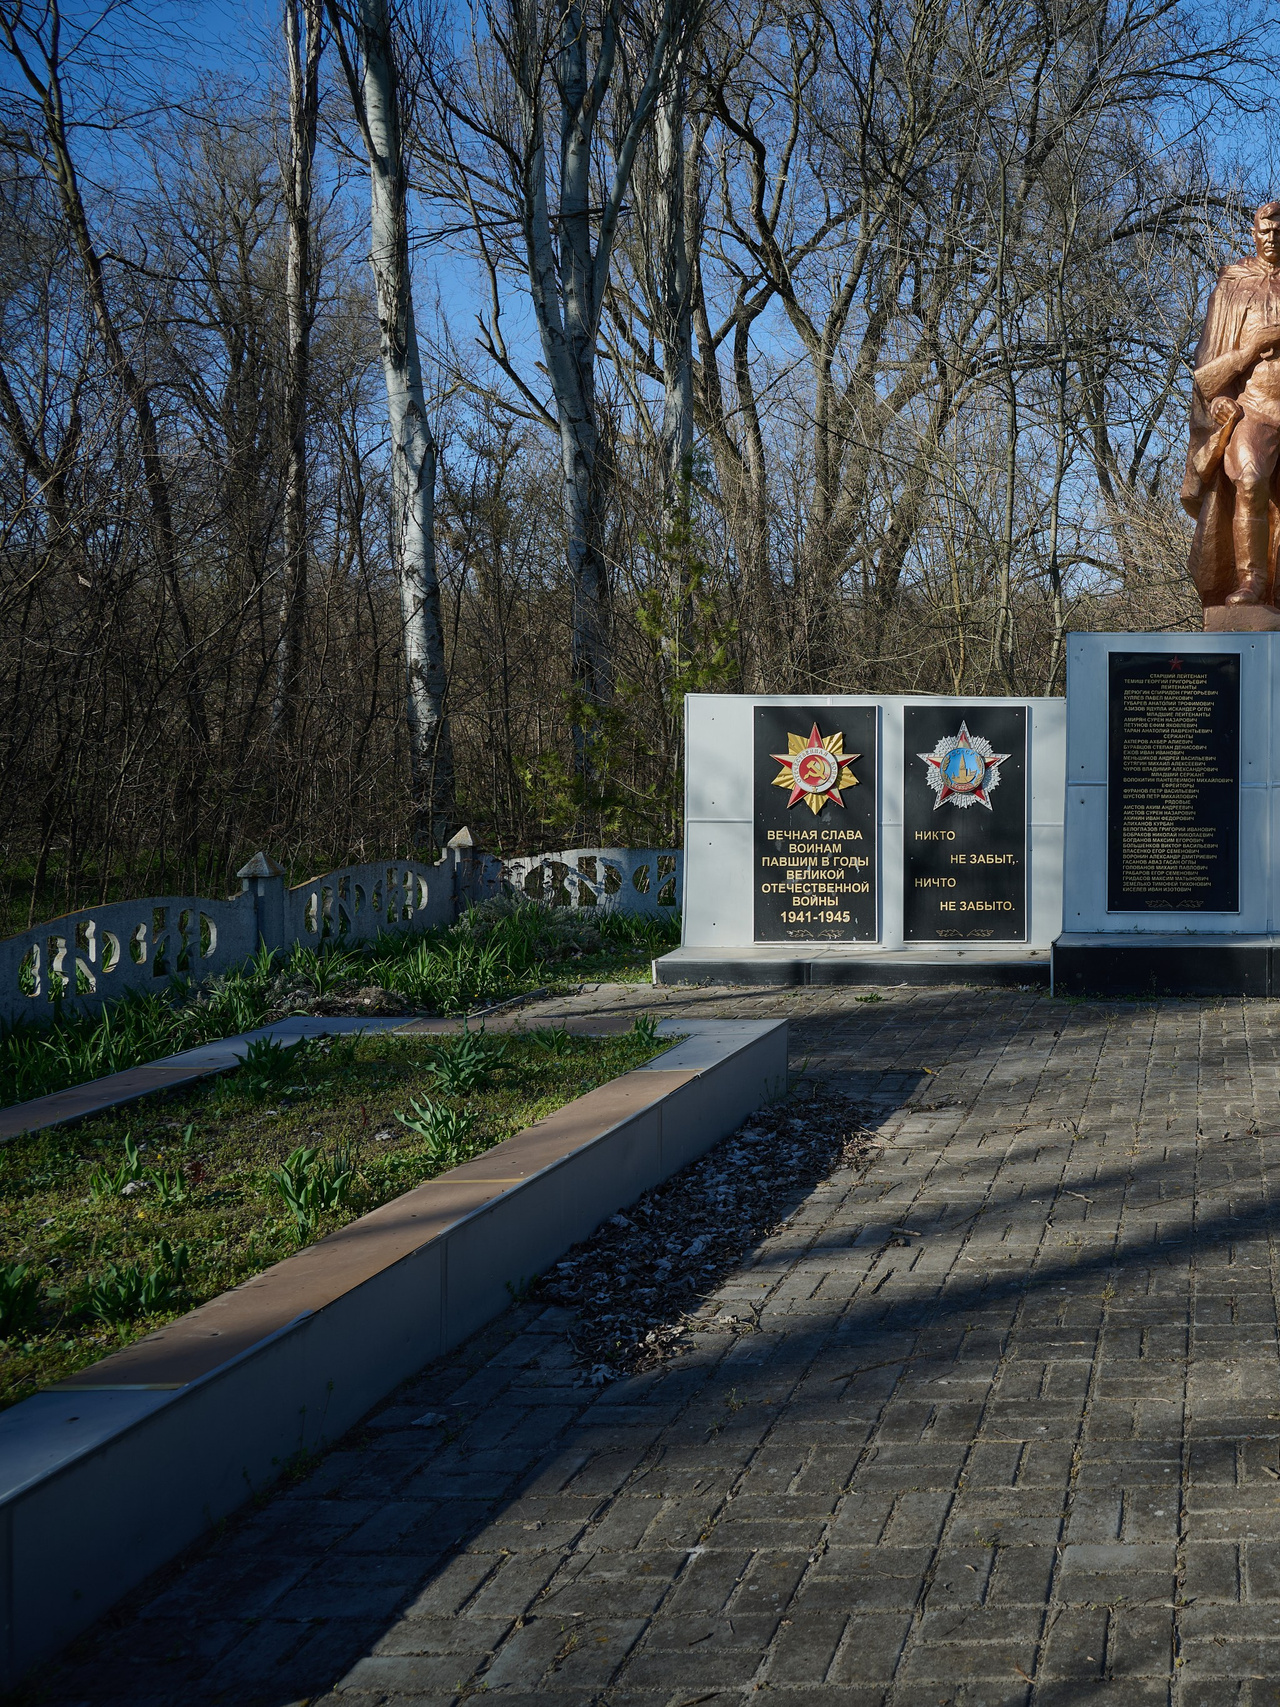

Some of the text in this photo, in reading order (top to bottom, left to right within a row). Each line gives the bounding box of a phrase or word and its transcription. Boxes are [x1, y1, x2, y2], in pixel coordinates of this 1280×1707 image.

[767, 830, 863, 840] ВЕЧНАЯ СЛАВА
[915, 831, 956, 840] НИКТО
[789, 844, 842, 853] ВОИНАМ
[762, 857, 869, 868] ПАВШИМ В ГОДЫ
[950, 854, 1015, 865] НЕ ЗАБЫТ,
[786, 868, 844, 880] ВЕЛИКОЙ
[761, 881, 869, 893] ОТЕЧЕСТВЕННОЙ
[915, 878, 956, 887] НИЧТО
[792, 895, 838, 906] ВОЙНЫ
[940, 901, 1015, 911] НЕ ЗАБЫТО.
[780, 911, 850, 923] 1941-1945
